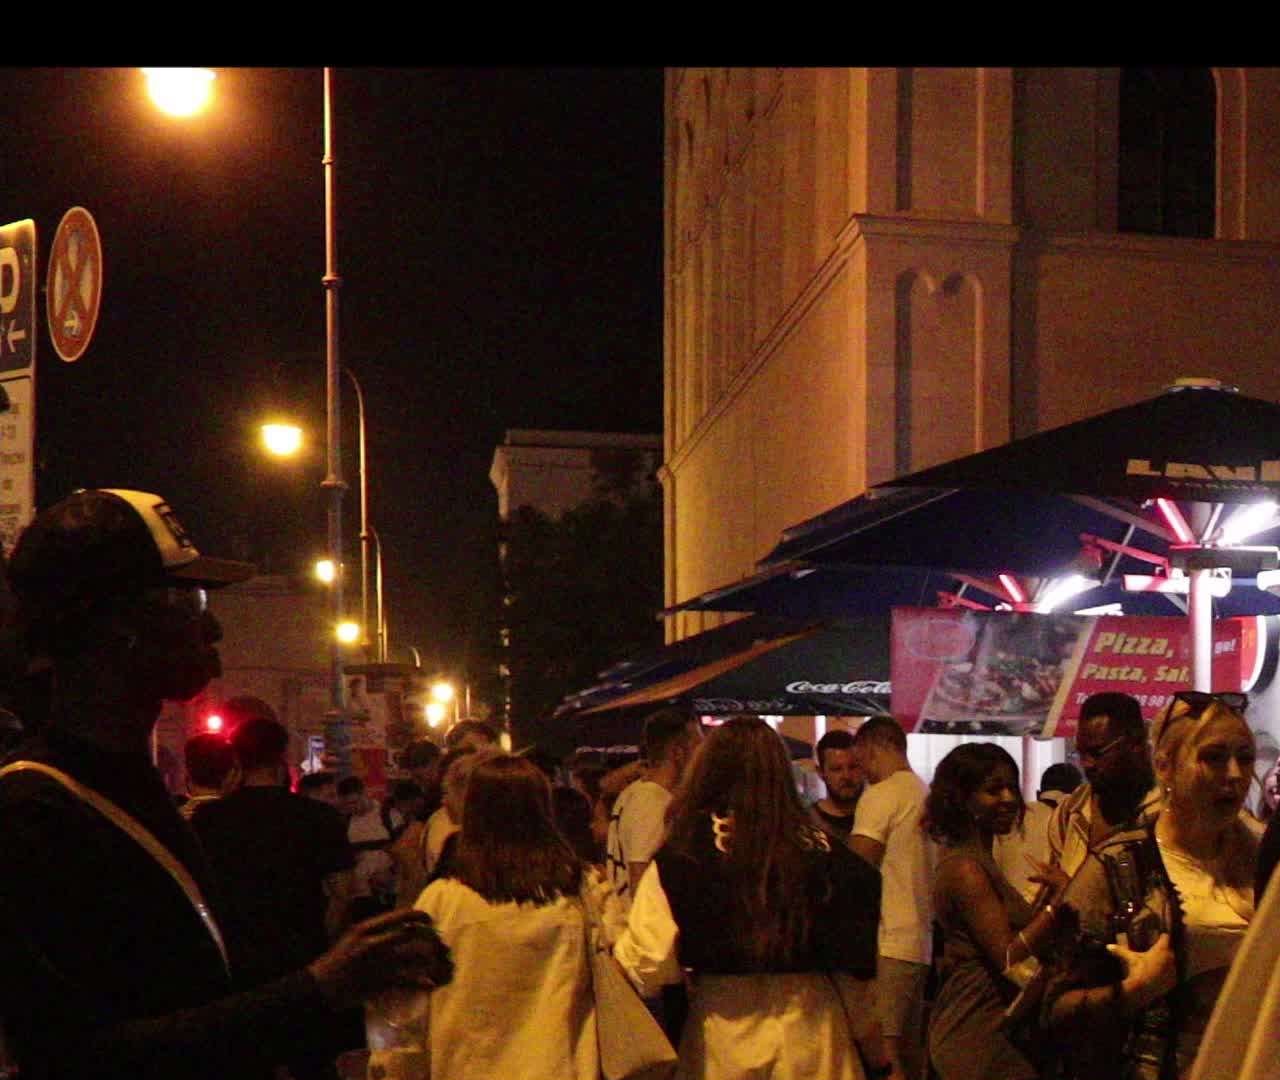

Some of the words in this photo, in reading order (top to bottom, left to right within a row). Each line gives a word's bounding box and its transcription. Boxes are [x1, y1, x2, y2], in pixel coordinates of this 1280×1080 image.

[1093, 630, 1175, 659] Pizza,
[1081, 663, 1148, 684] Pasta,
[1153, 665, 1190, 683] Sal
